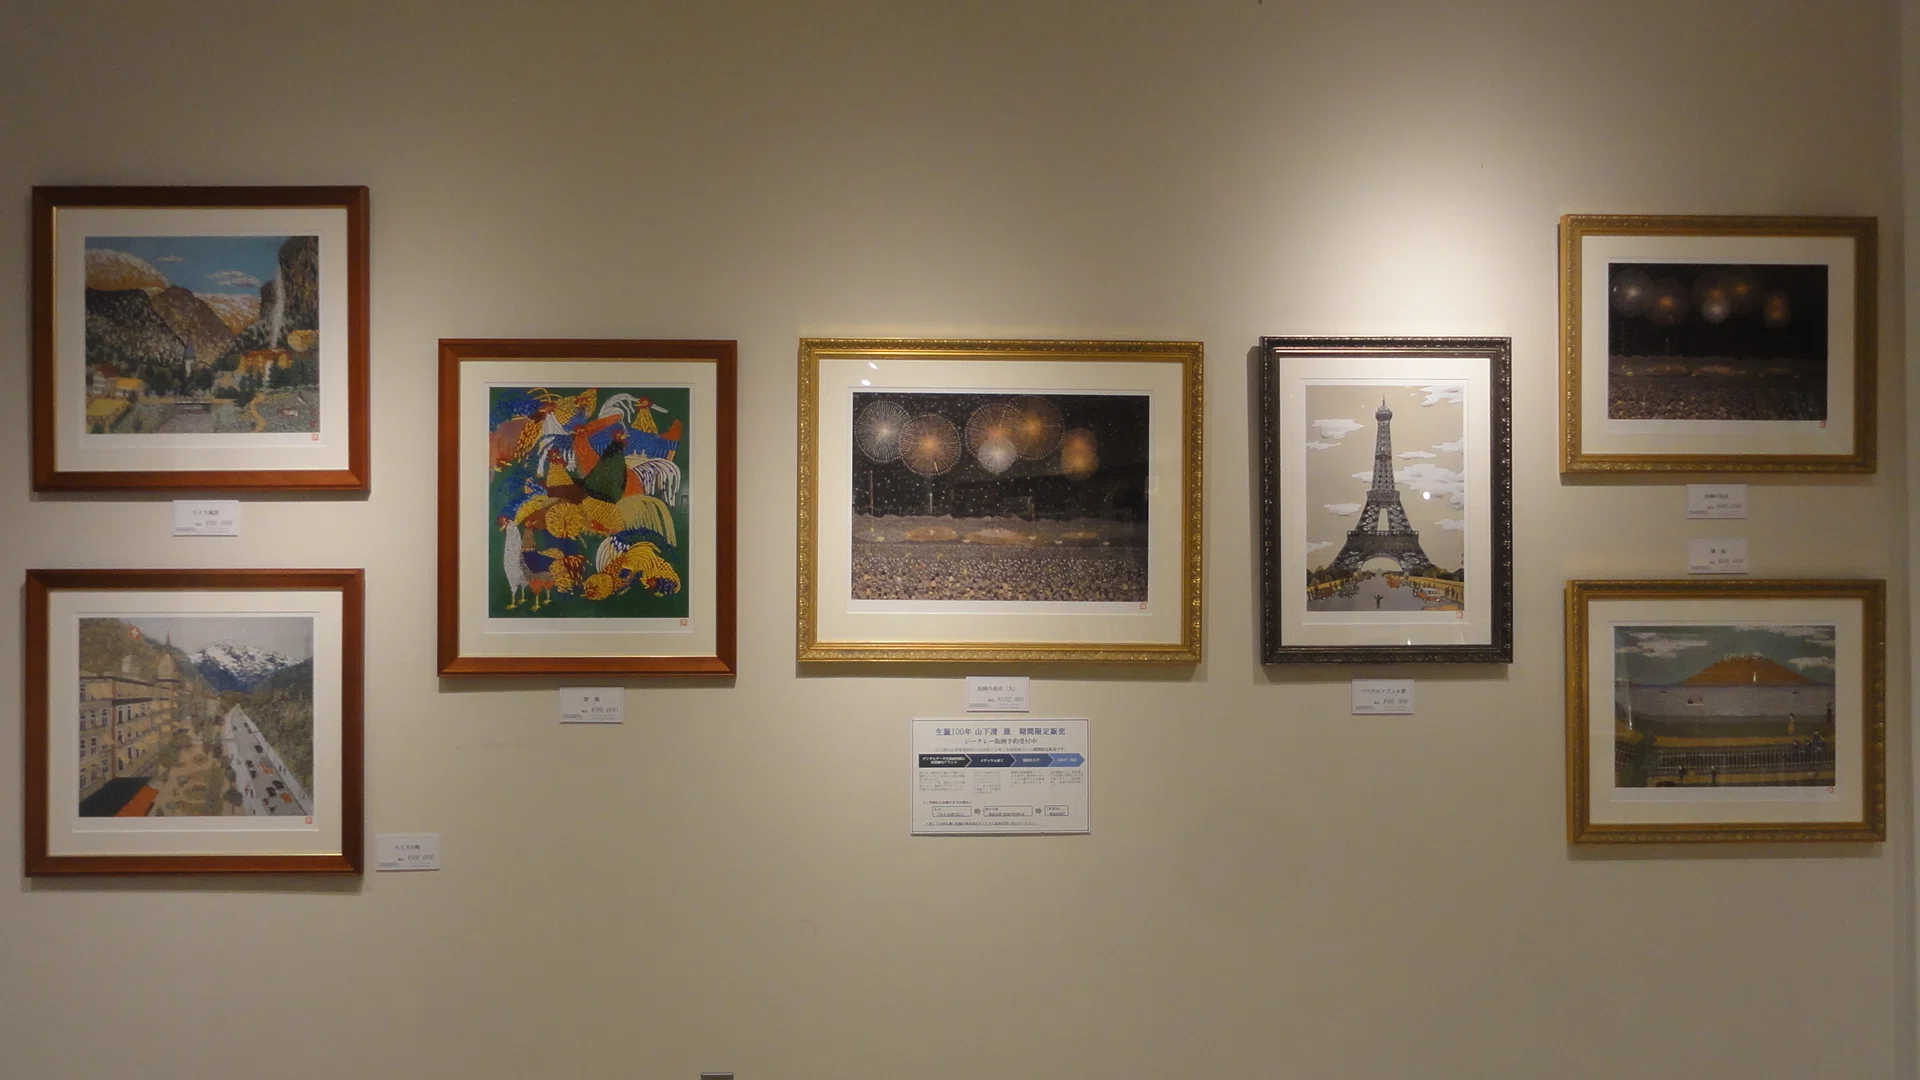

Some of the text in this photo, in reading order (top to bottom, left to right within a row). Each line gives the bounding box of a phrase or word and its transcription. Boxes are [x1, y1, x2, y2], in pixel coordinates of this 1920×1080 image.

[936, 728, 972, 736] 生誕100年
[974, 728, 998, 736] 山下清
[1019, 727, 1066, 736] 期間限定販売
